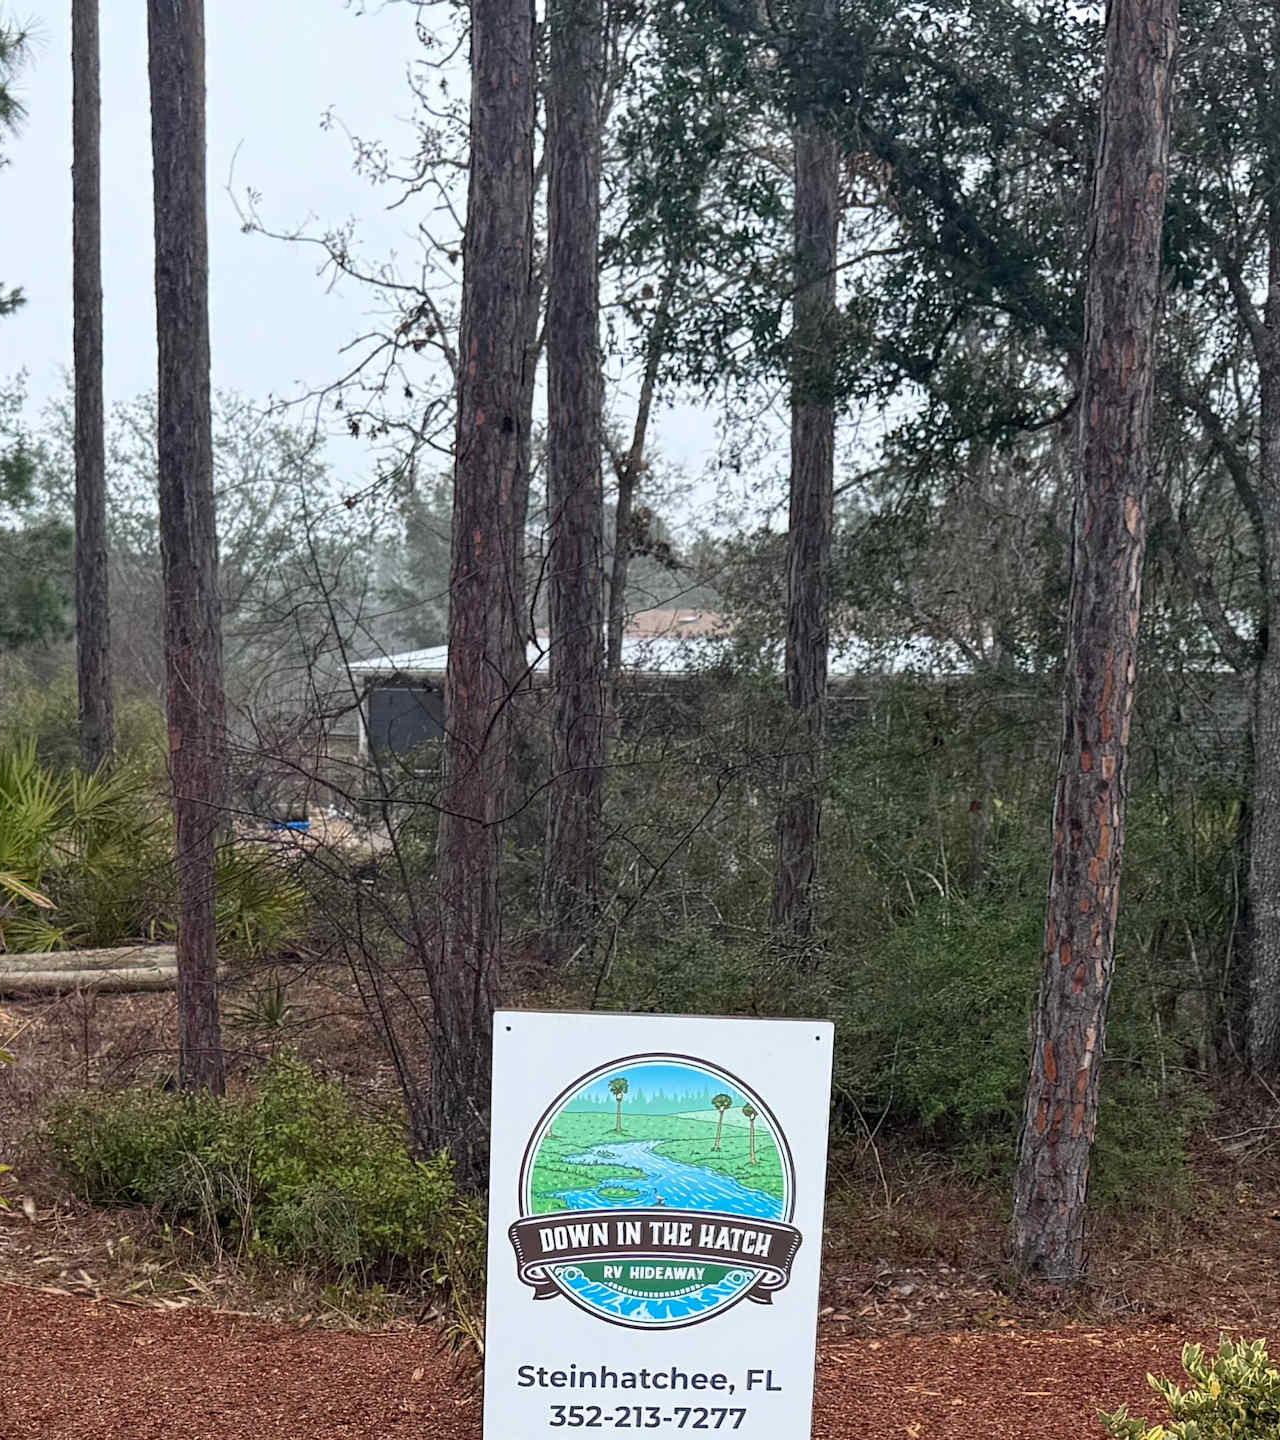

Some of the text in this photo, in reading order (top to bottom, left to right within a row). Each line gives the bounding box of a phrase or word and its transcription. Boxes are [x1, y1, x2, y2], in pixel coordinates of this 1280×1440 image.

[539, 1221, 773, 1258] DOWN IN THE HATCH
[603, 1265, 706, 1281] RV HIDEAWAY
[517, 1363, 783, 1396] Steinhatchee, FL
[548, 1404, 748, 1430] 352-213-7277
